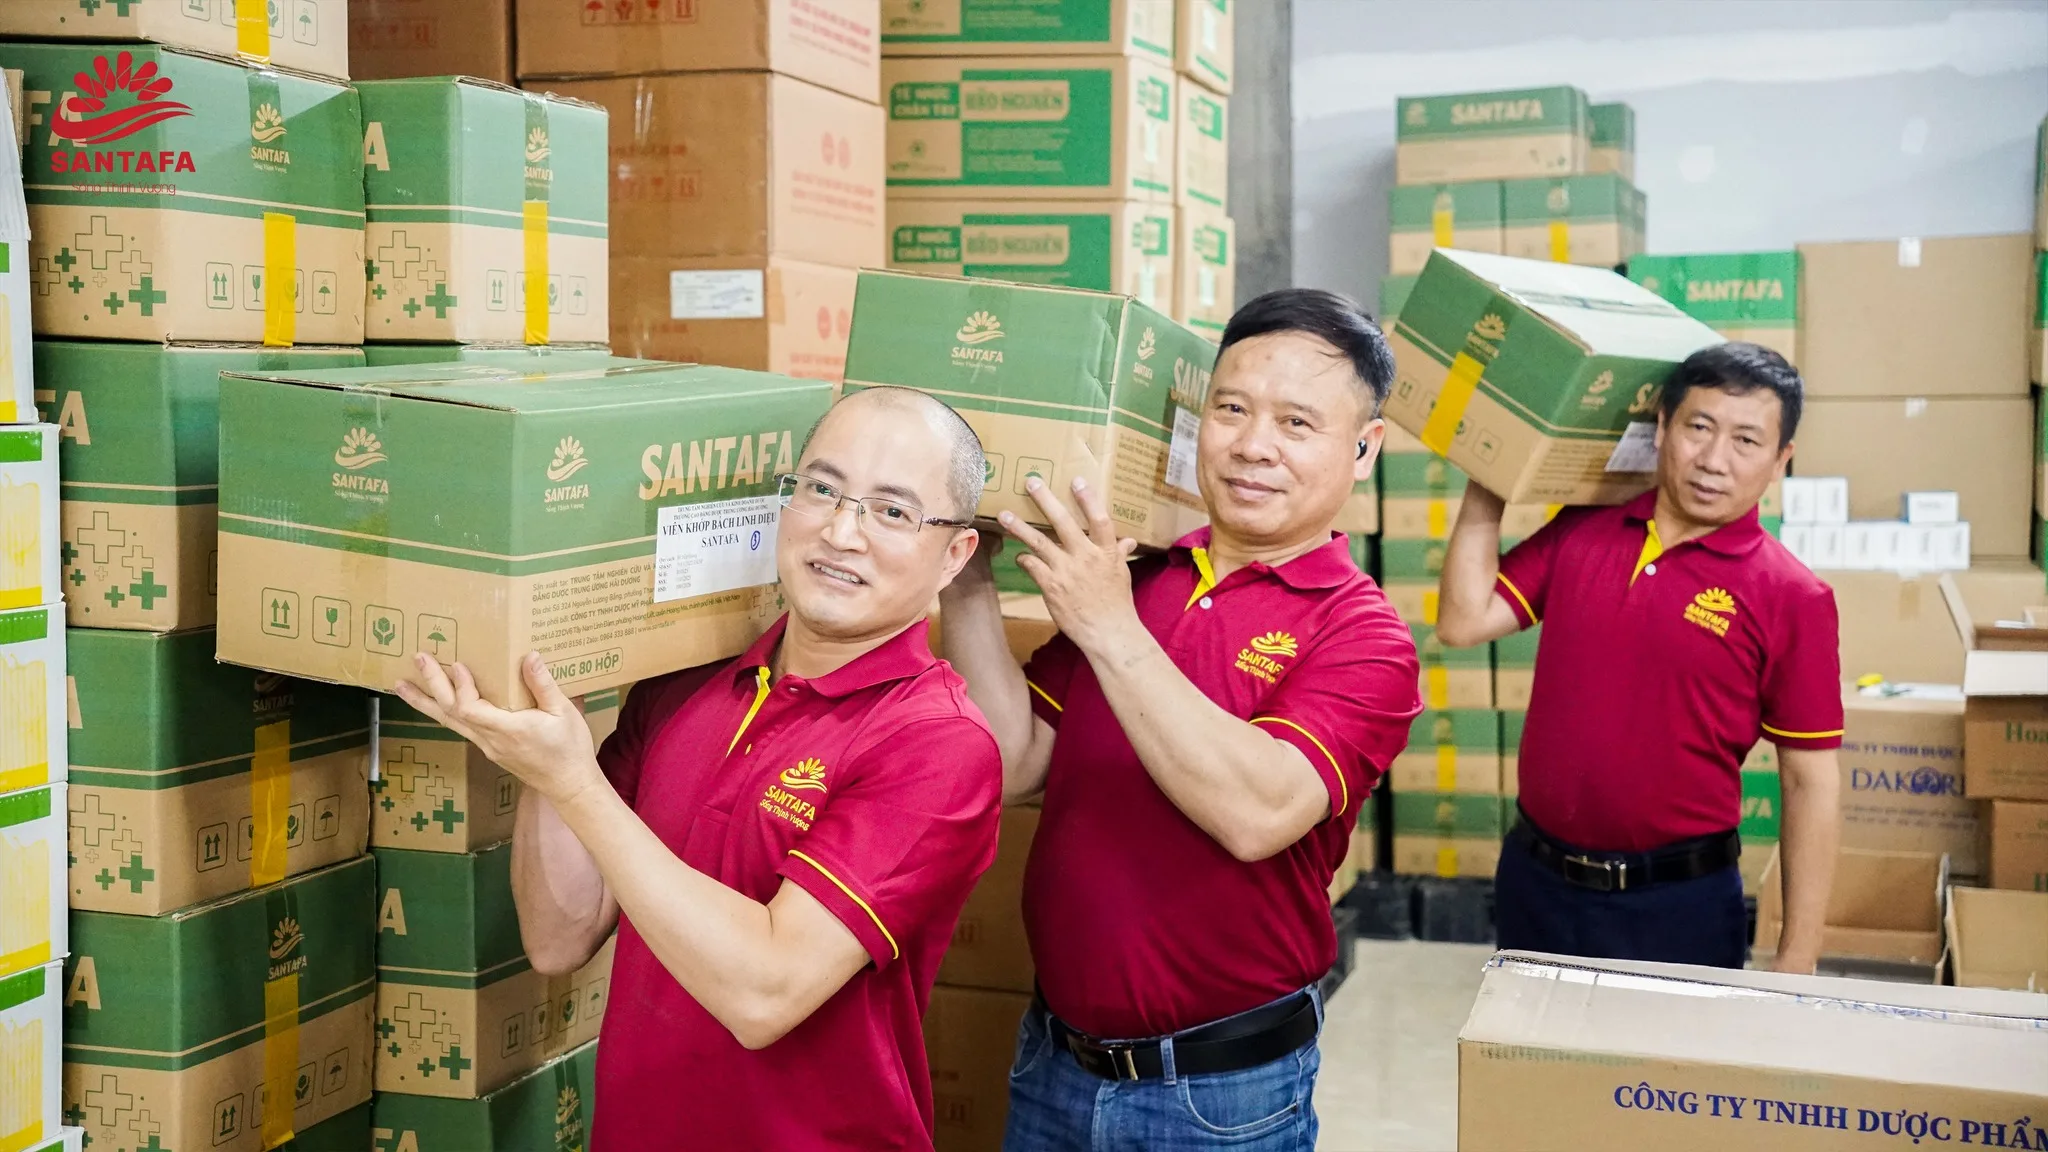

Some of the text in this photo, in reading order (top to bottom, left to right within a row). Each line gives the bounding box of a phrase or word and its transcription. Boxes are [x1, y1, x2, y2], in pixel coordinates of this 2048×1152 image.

[251, 146, 291, 164] SANTAFA
[1687, 278, 1783, 302] SANTAFA
[951, 346, 1003, 364] SANTAFA
[1170, 356, 1211, 413] SANT
[638, 430, 794, 500] SANTAFA
[332, 472, 389, 494] SANTAFA
[544, 484, 589, 502] SANTAFA
[685, 518, 711, 534] KHỚP
[736, 514, 756, 527] LINH
[758, 512, 777, 526] DIỆU
[701, 534, 740, 548] SANTAFA
[570, 574, 591, 585] TRUNG
[592, 570, 605, 580] TÂM
[606, 568, 628, 579] NGHIÊN
[570, 584, 591, 596] TRUNG
[620, 576, 641, 587] DƯƠNG
[560, 602, 572, 611] 324
[570, 611, 588, 622] CÔNG
[588, 608, 597, 618] TY
[597, 606, 614, 616] TNHH
[614, 602, 631, 614] DƯỢC
[1685, 602, 1730, 631] SANTAFA
[554, 640, 568, 651] 1800
[568, 638, 583, 648] 8156
[600, 632, 613, 642] 0964
[614, 630, 624, 638] 333
[625, 628, 635, 636] 888
[549, 652, 619, 680] ÙNG 80 HỘP
[1238, 648, 1284, 674] SANTAF
[765, 785, 816, 820] SANTAFA
[772, 805, 790, 820] Thịnh
[268, 955, 308, 980] SANTAFA
[1613, 1081, 1699, 1115] CÔNG
[1705, 1094, 1747, 1119] TY
[1754, 1098, 1850, 1130] TNHH
[1857, 1108, 1952, 1144] DƯỢC
